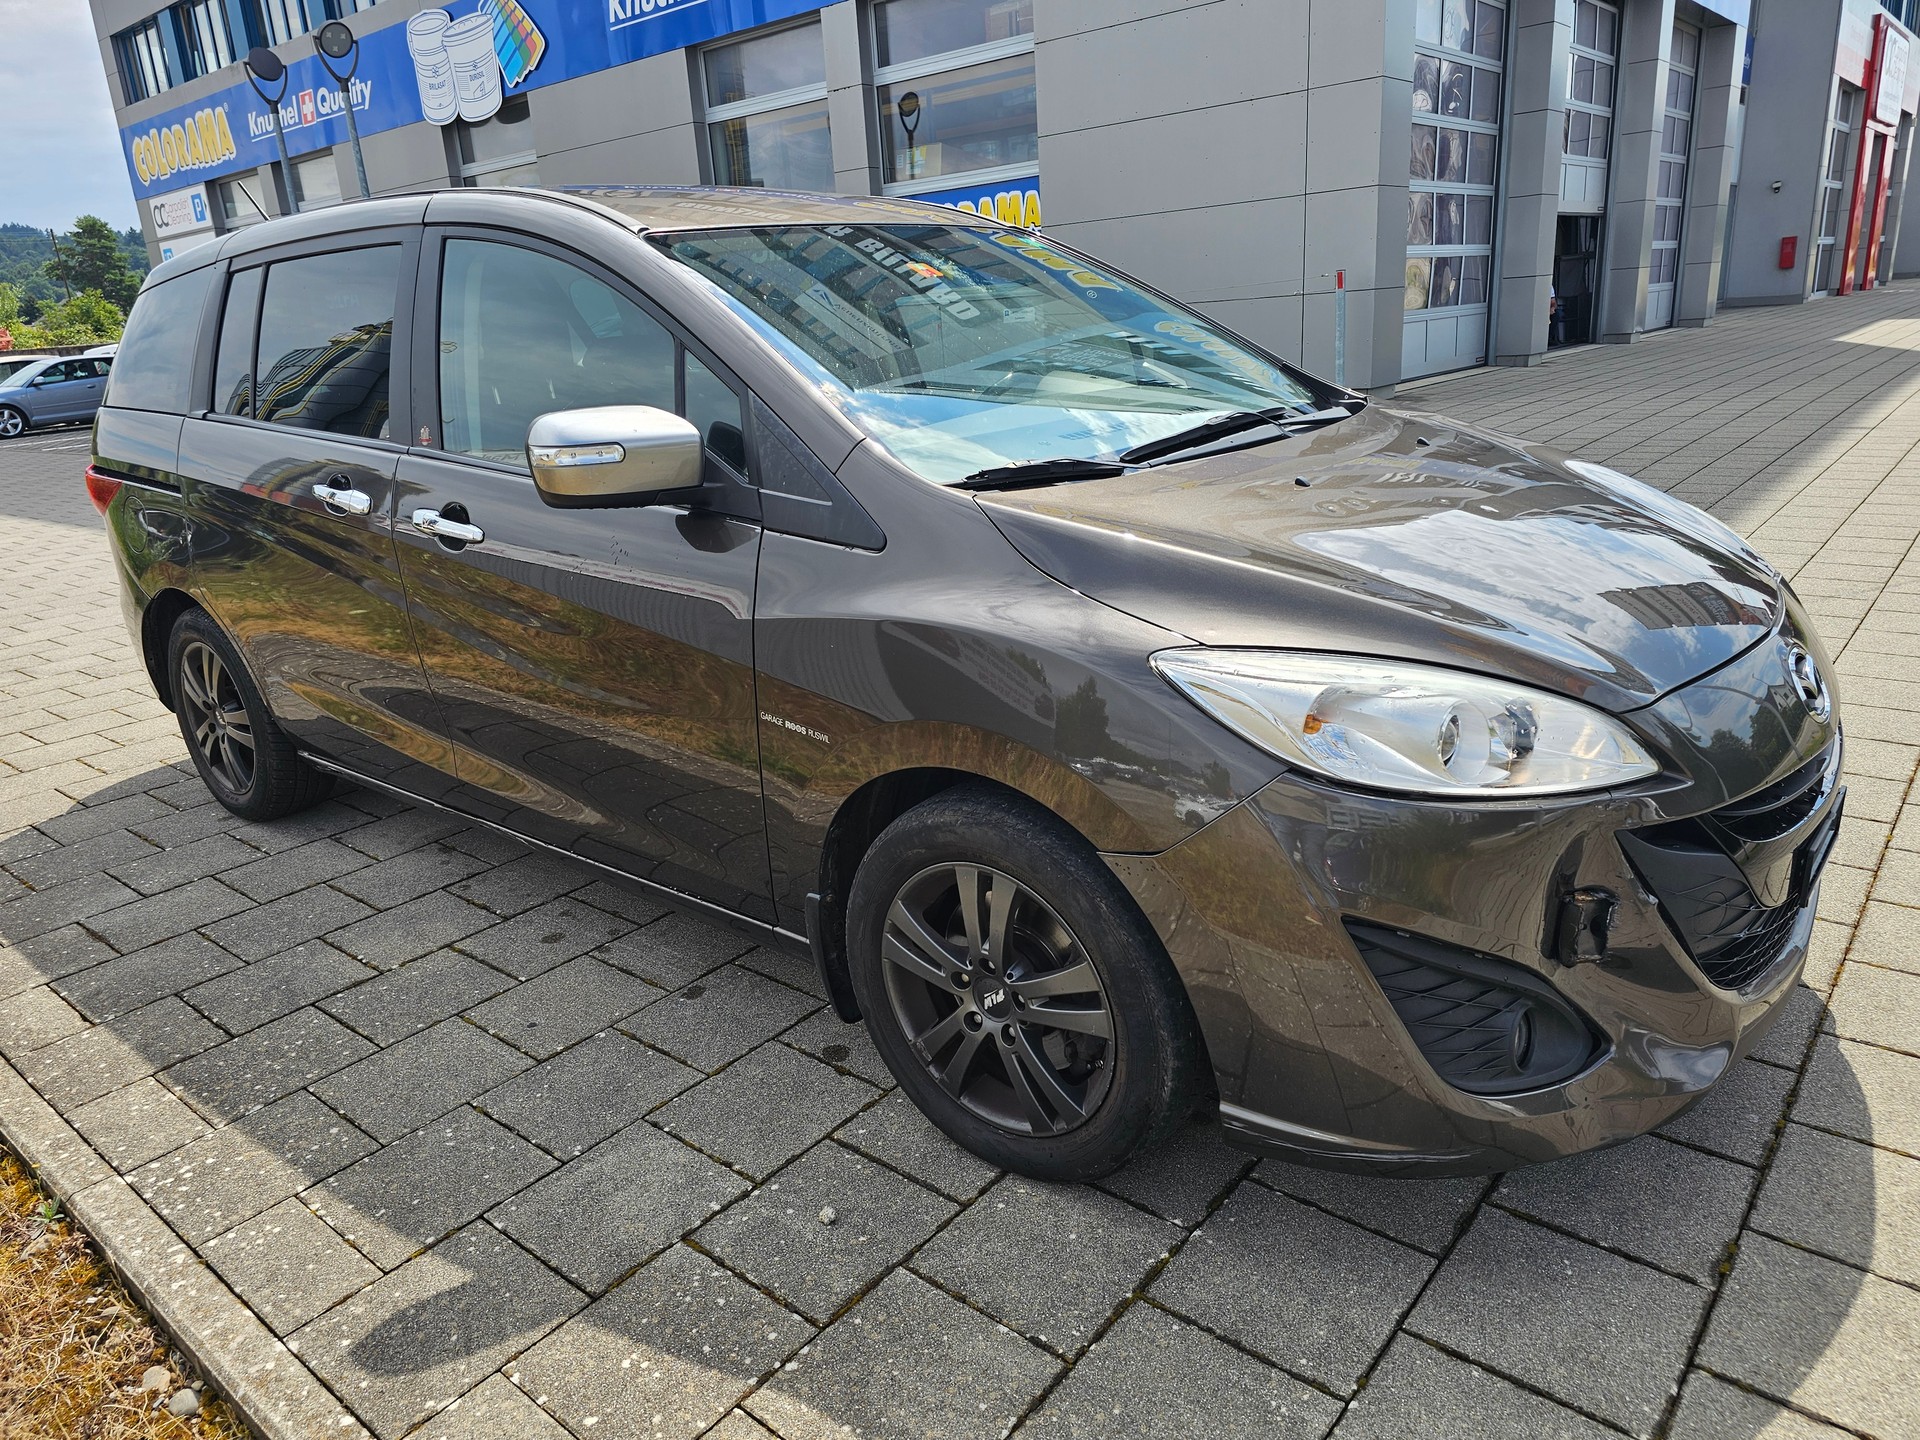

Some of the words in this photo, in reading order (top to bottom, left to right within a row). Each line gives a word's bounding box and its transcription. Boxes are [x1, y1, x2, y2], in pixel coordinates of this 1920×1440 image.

[248, 95, 299, 137] Knuhel
[133, 107, 236, 186] COLORAMA
[760, 711, 784, 727] GARAGE
[785, 720, 807, 735] ROOS
